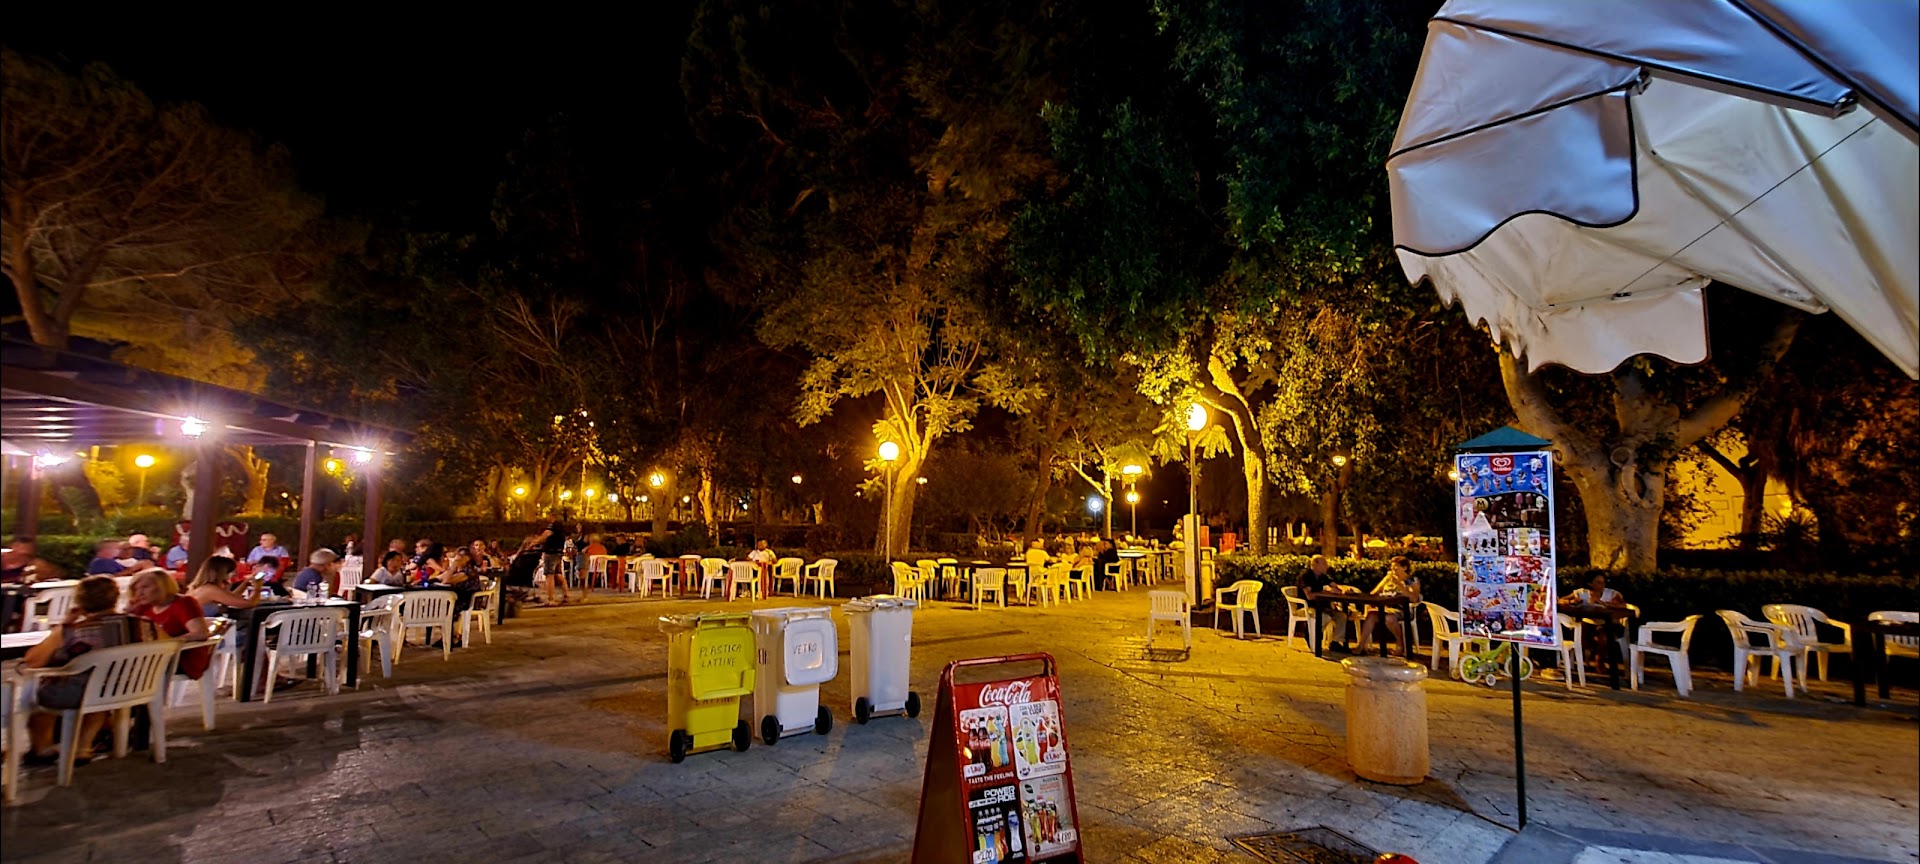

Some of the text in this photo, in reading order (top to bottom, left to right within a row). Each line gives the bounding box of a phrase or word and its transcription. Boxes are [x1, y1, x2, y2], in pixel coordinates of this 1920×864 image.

[700, 643, 742, 658] PLASTICA
[793, 642, 818, 655] VETRO
[702, 658, 736, 668] LATTINE
[968, 775, 983, 784] TASTE
[984, 774, 993, 782] THE
[993, 771, 1015, 780] FEELING
[984, 785, 1015, 798] POWER
